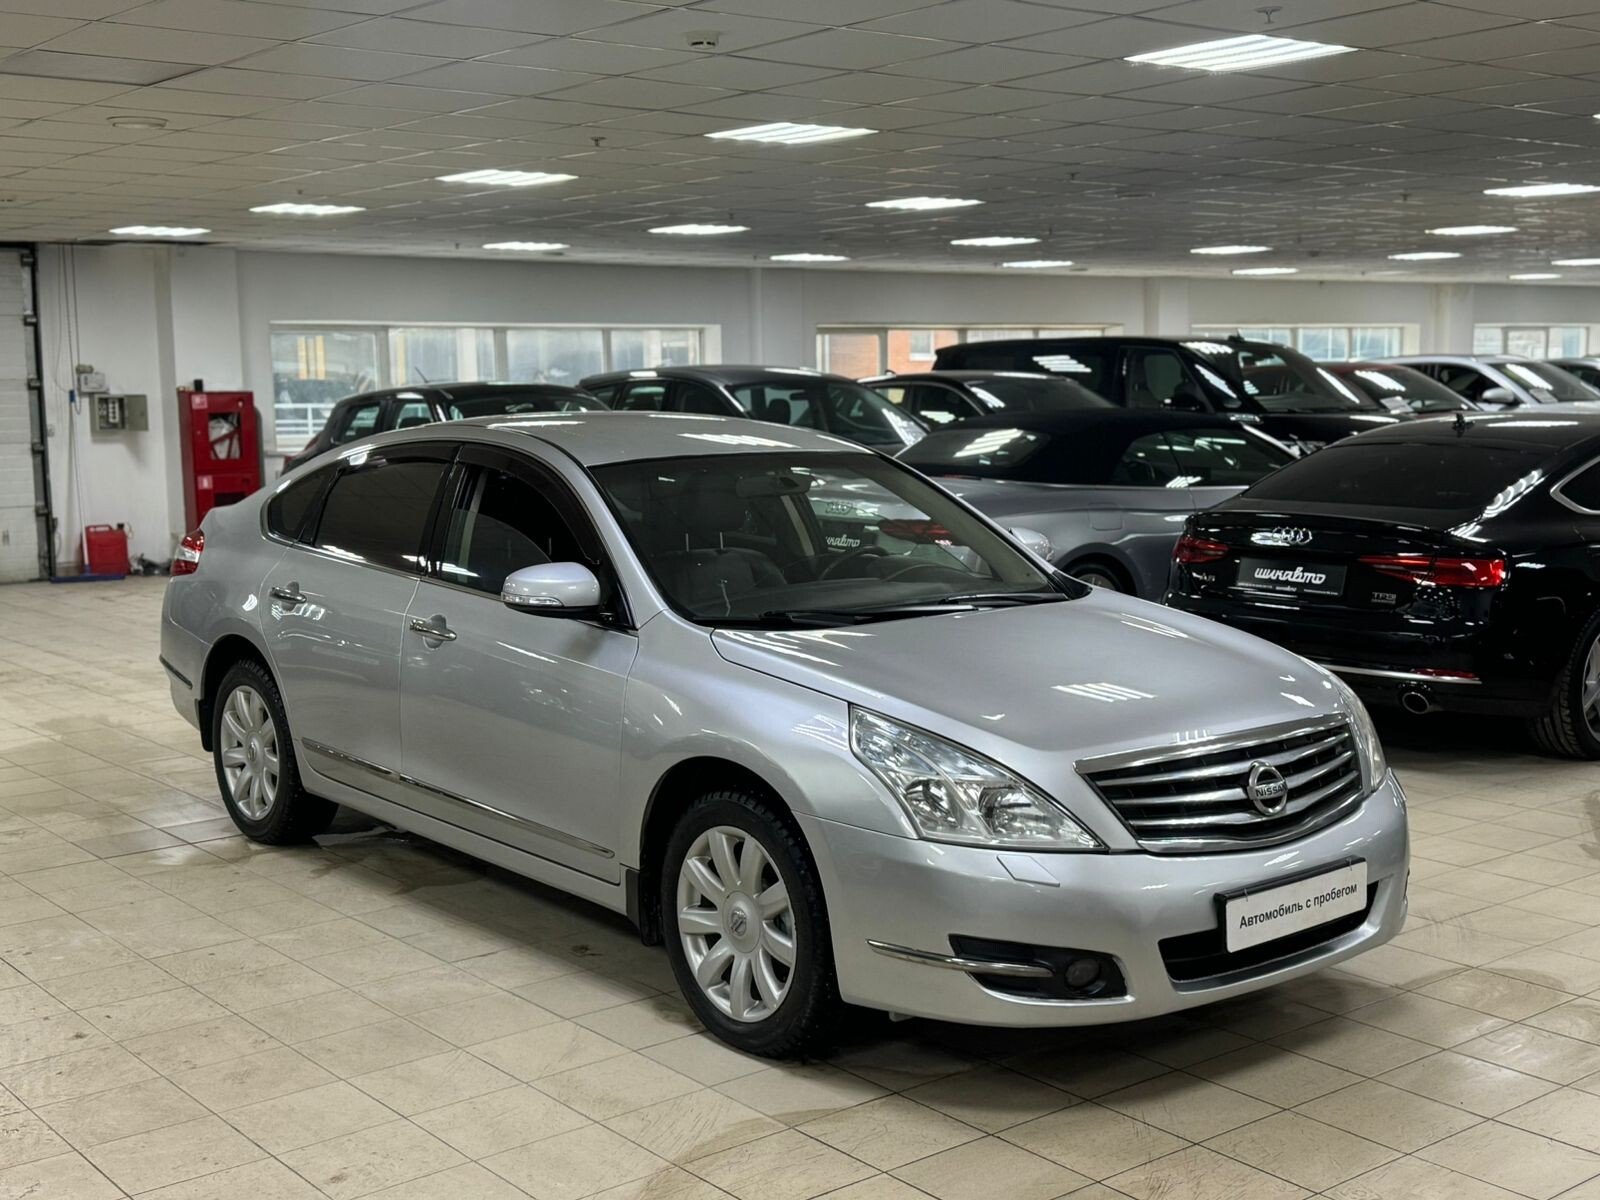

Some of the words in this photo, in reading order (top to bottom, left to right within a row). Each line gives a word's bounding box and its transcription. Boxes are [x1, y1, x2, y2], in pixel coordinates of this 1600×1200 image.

[1255, 783, 1288, 798] NISSAN
[1239, 903, 1304, 929] Автомобиль
[1305, 899, 1312, 909] с
[1313, 883, 1358, 908] пробегом
